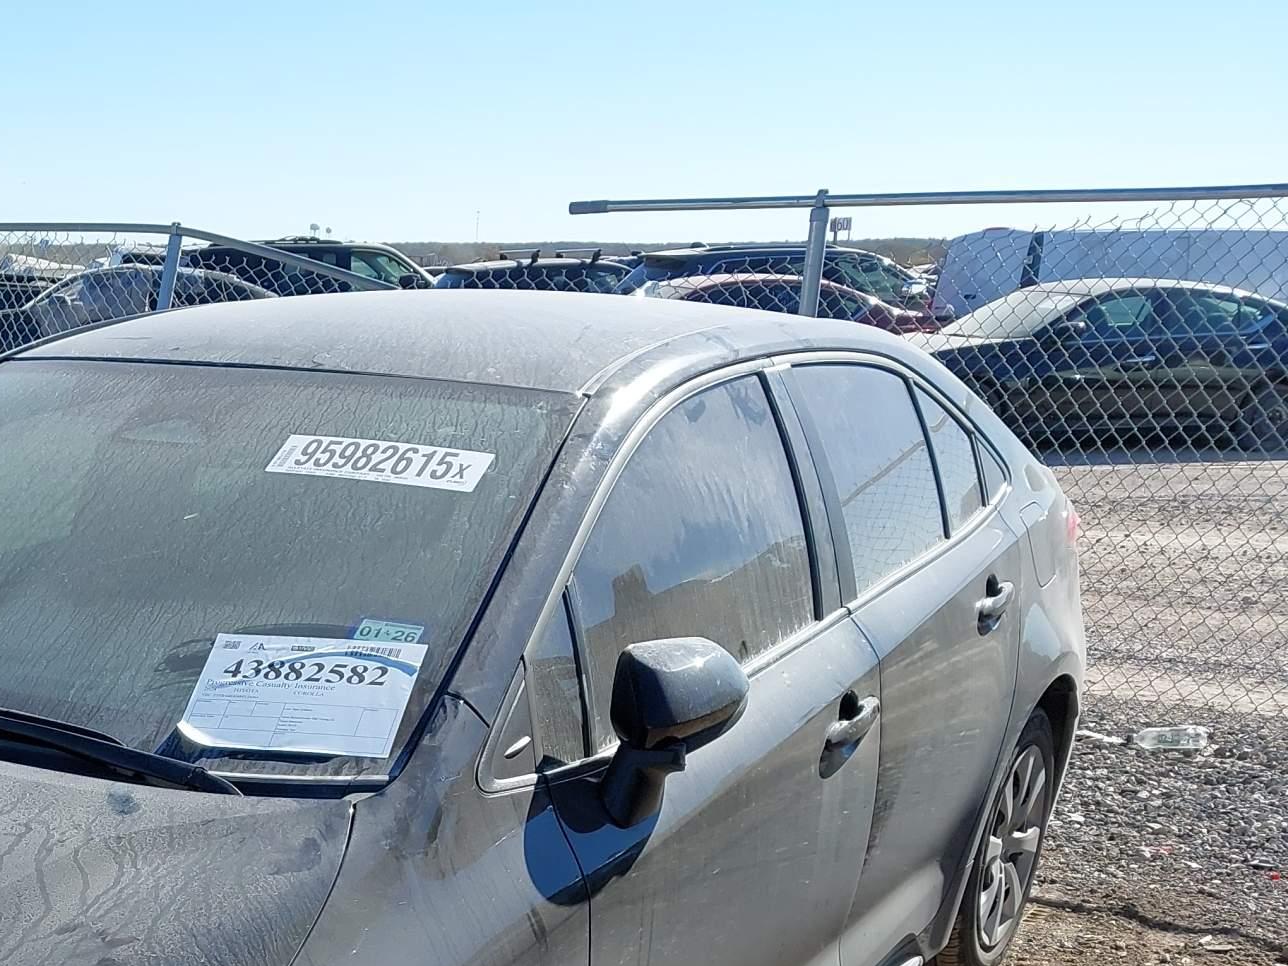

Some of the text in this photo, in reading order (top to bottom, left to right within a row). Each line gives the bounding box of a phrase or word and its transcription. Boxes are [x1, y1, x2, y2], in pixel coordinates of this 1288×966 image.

[223, 657, 389, 687] 43882582
[255, 680, 292, 690] Casualty
[294, 682, 336, 692] Insurance
